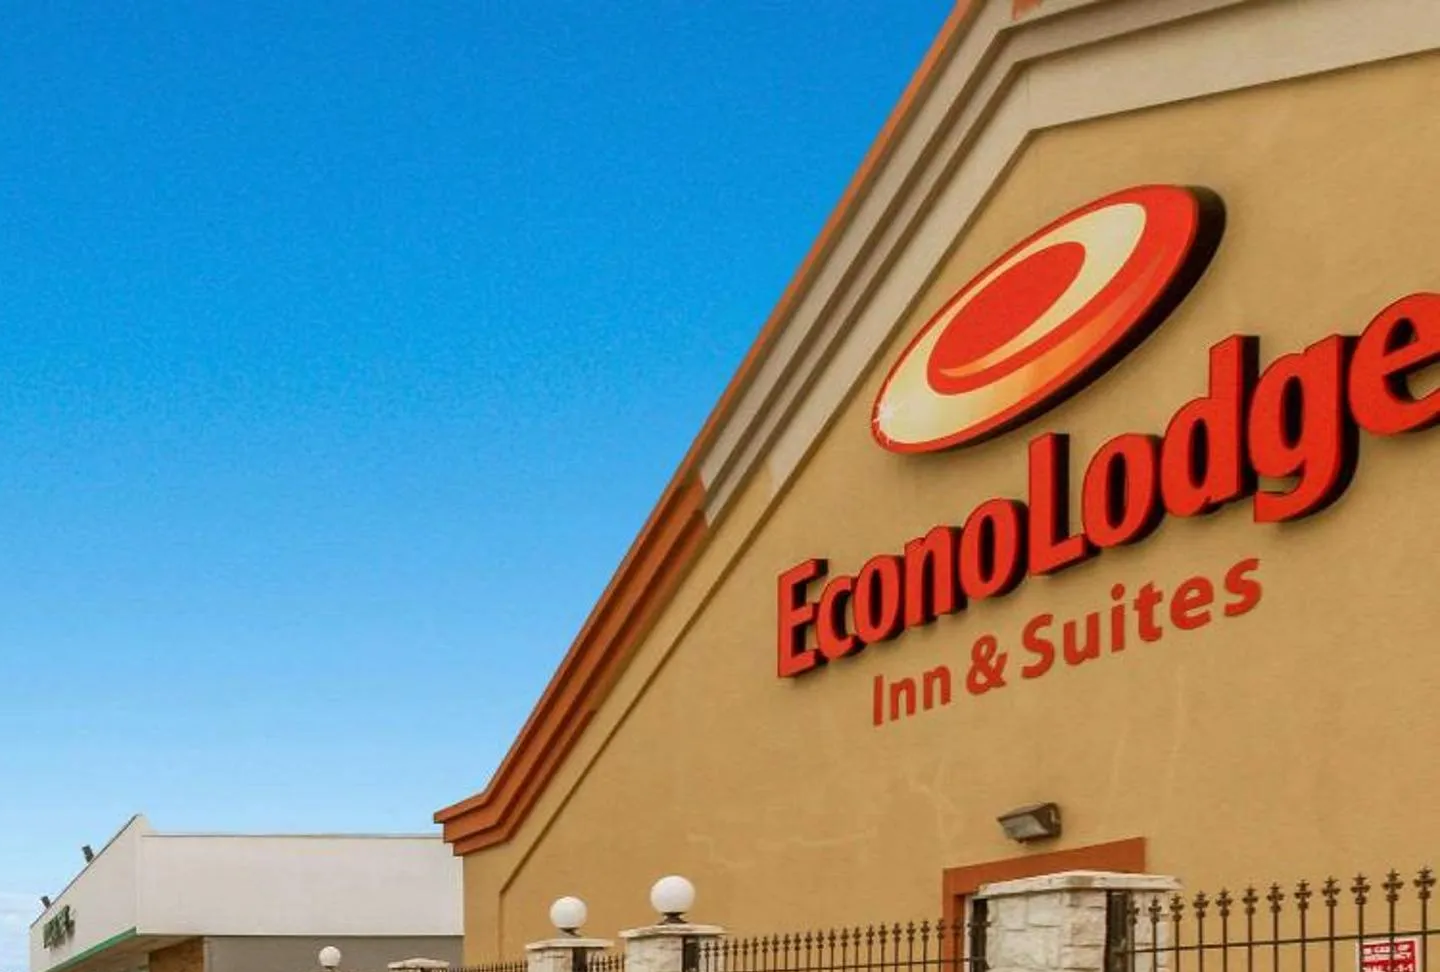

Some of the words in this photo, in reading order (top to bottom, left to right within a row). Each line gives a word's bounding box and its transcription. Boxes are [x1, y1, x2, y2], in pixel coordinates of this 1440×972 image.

[872, 664, 952, 727] Inn
[966, 634, 1009, 695] &
[1021, 557, 1263, 680] Suites
